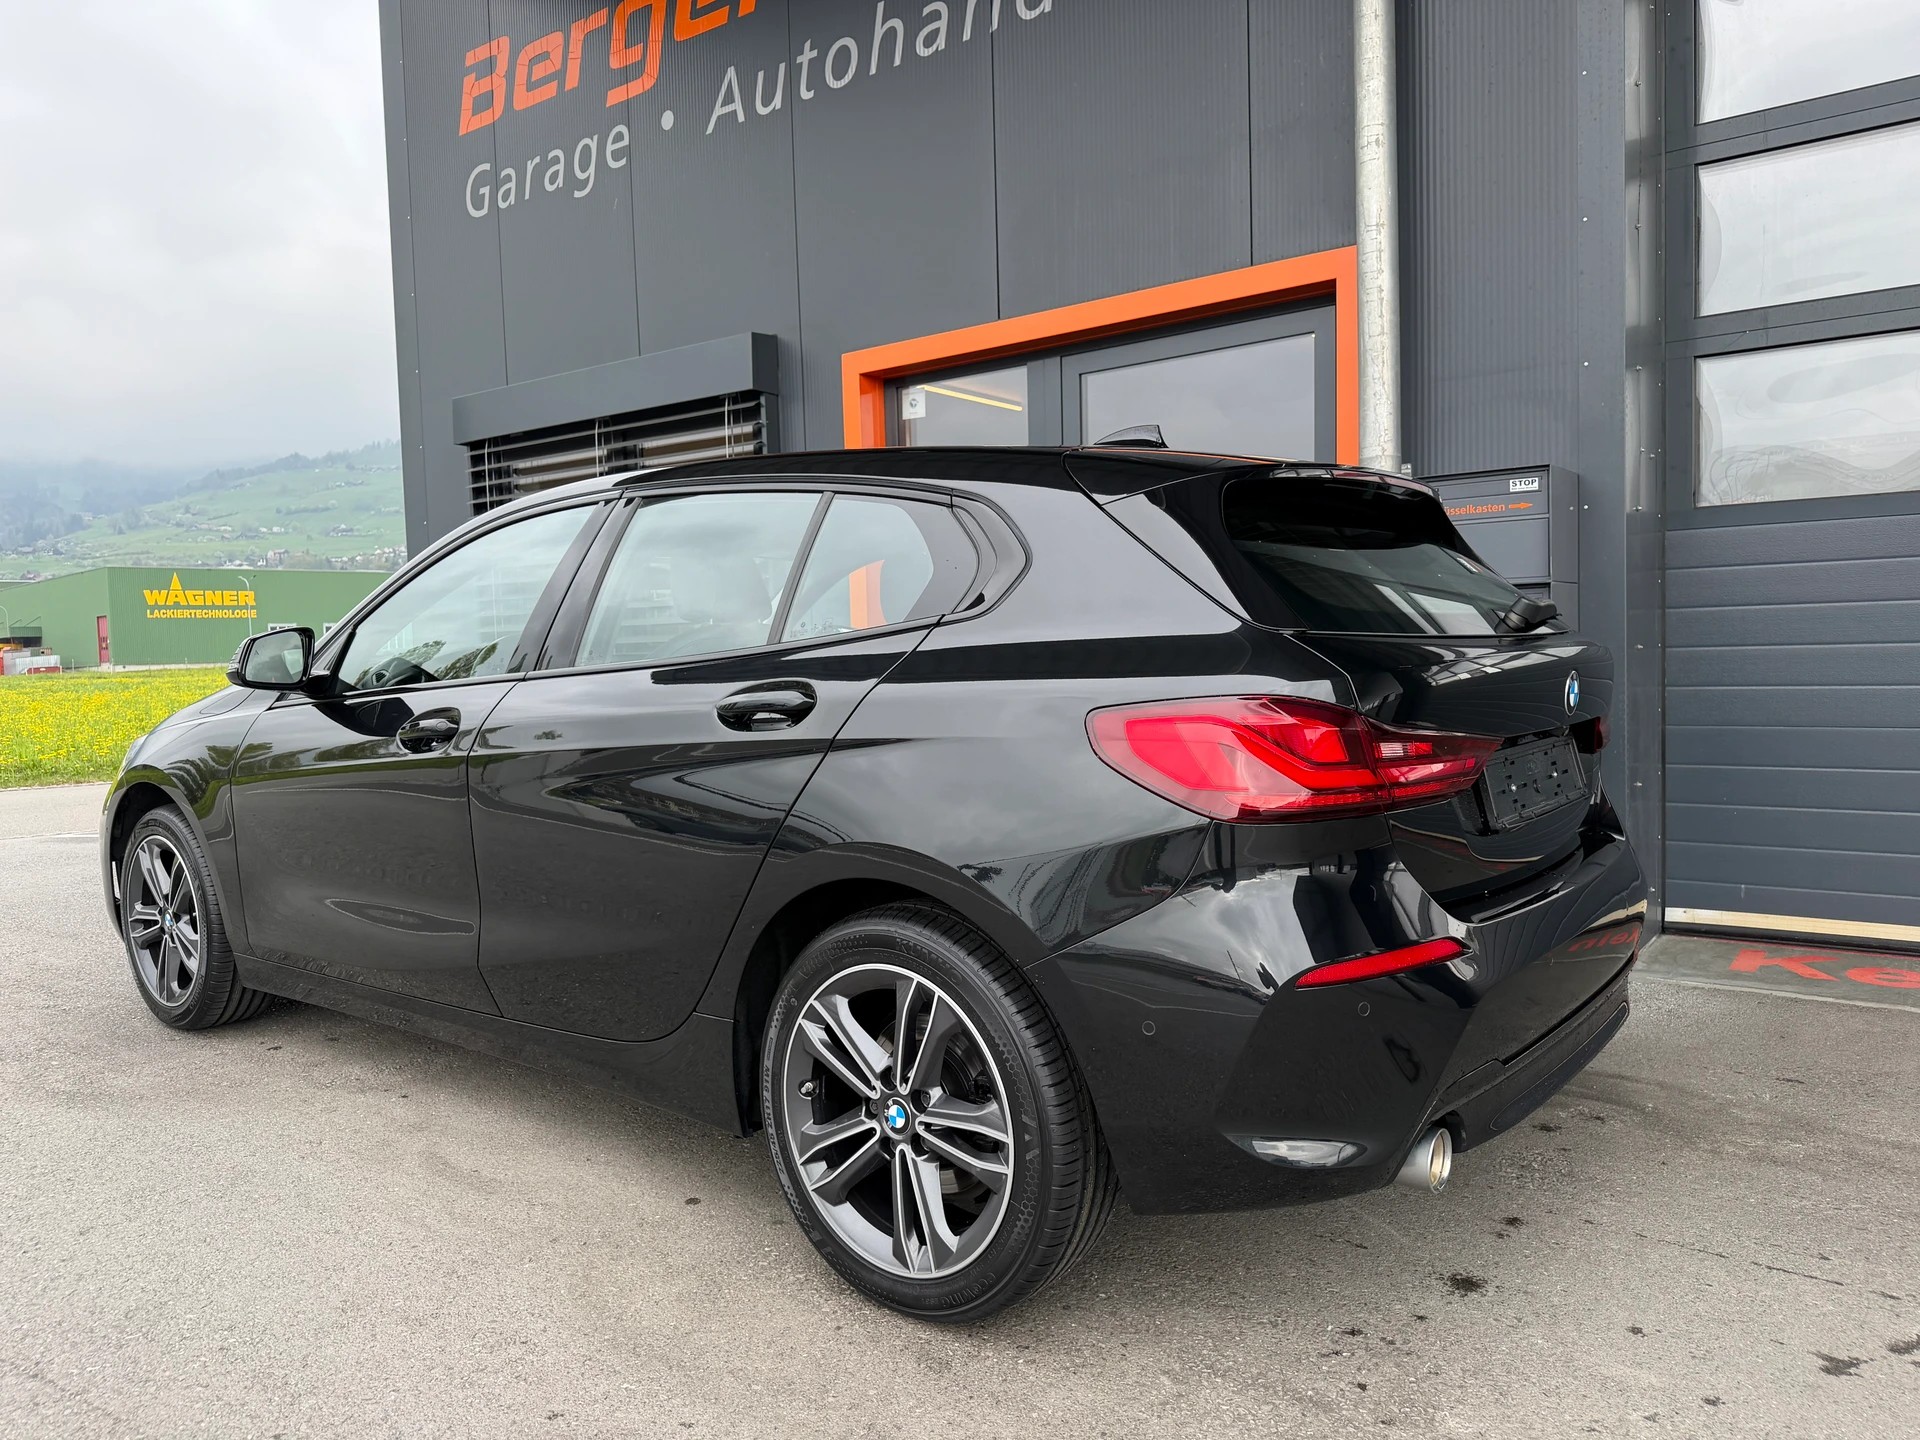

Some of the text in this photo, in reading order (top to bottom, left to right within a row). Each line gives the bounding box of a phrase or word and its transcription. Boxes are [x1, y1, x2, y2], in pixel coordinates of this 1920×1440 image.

[459, 0, 756, 136] Berge
[465, 0, 1052, 218] Garage Autohan
[1512, 479, 1537, 488] STOP
[1444, 504, 1506, 515] üsselkasten
[143, 572, 256, 606] WAGNER
[147, 609, 257, 619] LACKIERTECHNOLOGIE
